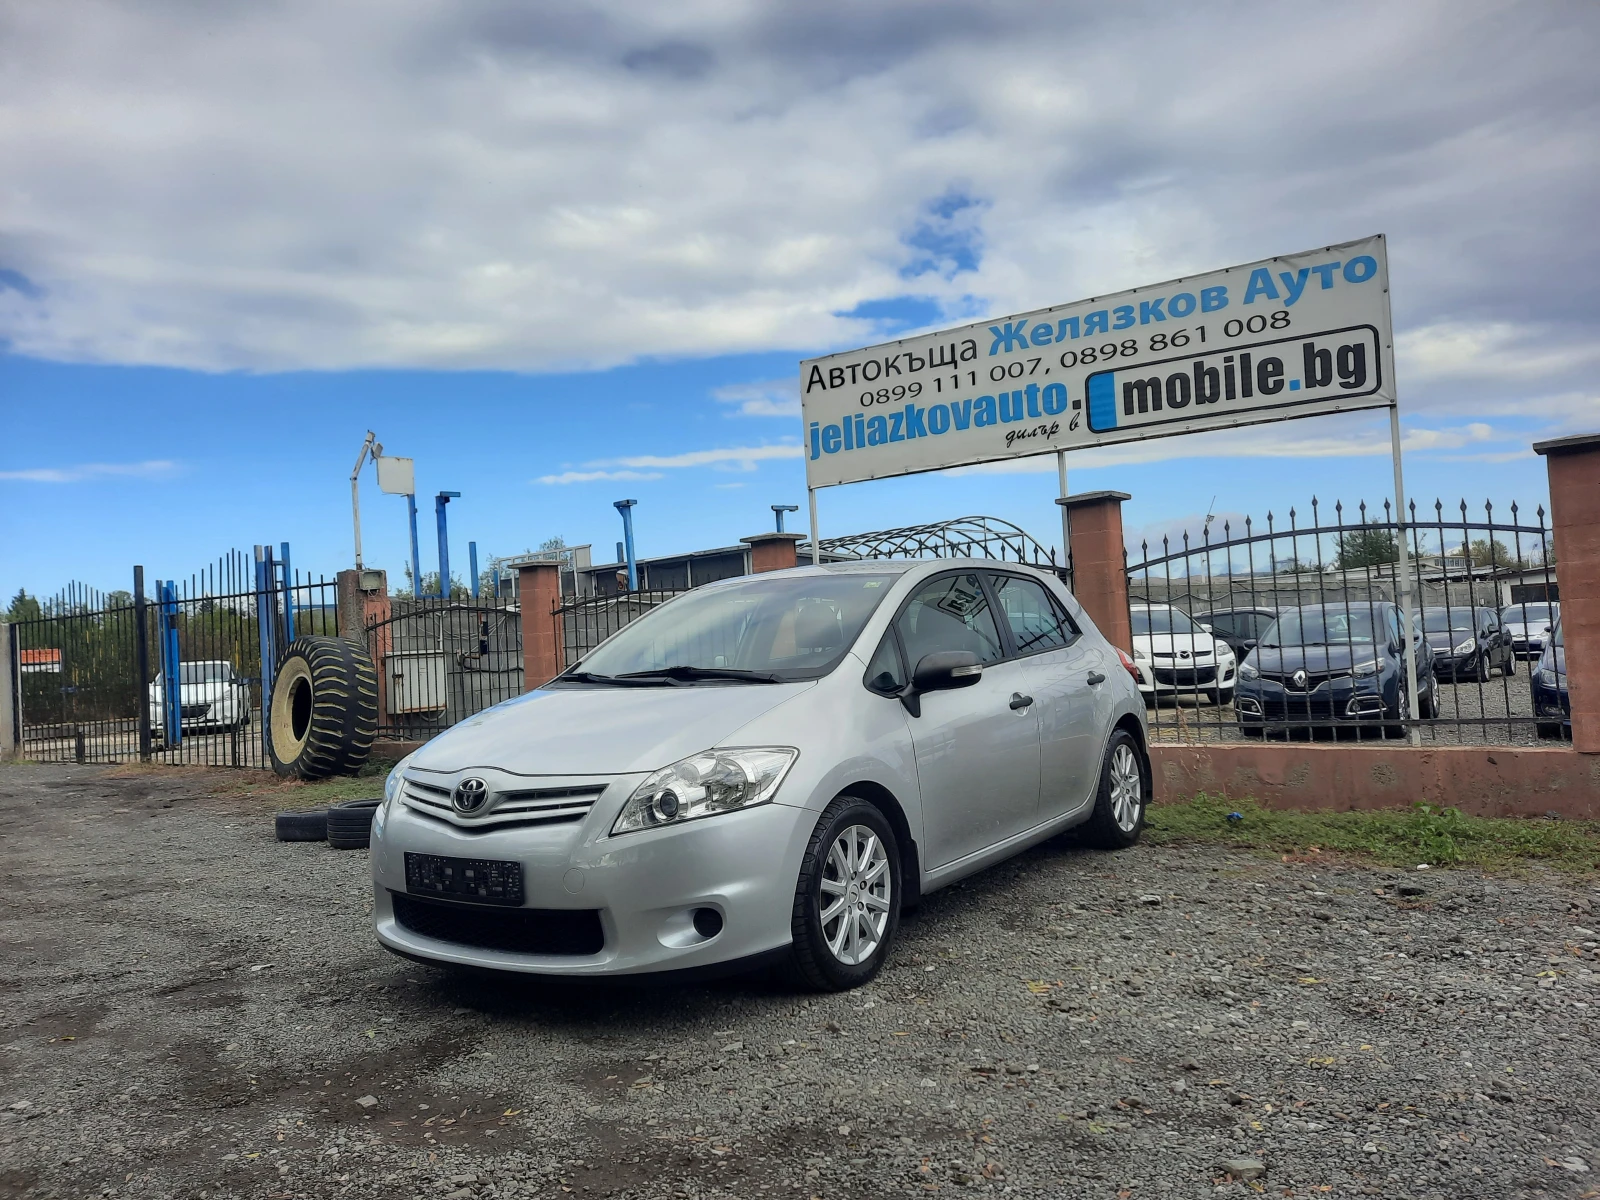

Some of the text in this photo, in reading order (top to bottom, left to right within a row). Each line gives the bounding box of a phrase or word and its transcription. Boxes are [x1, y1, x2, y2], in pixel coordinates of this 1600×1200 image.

[806, 255, 1378, 394] Автокъща Желязков Ауто
[859, 310, 1291, 407] 0899 111 007, 0898 861 008
[1122, 341, 1367, 416] mobile.bg
